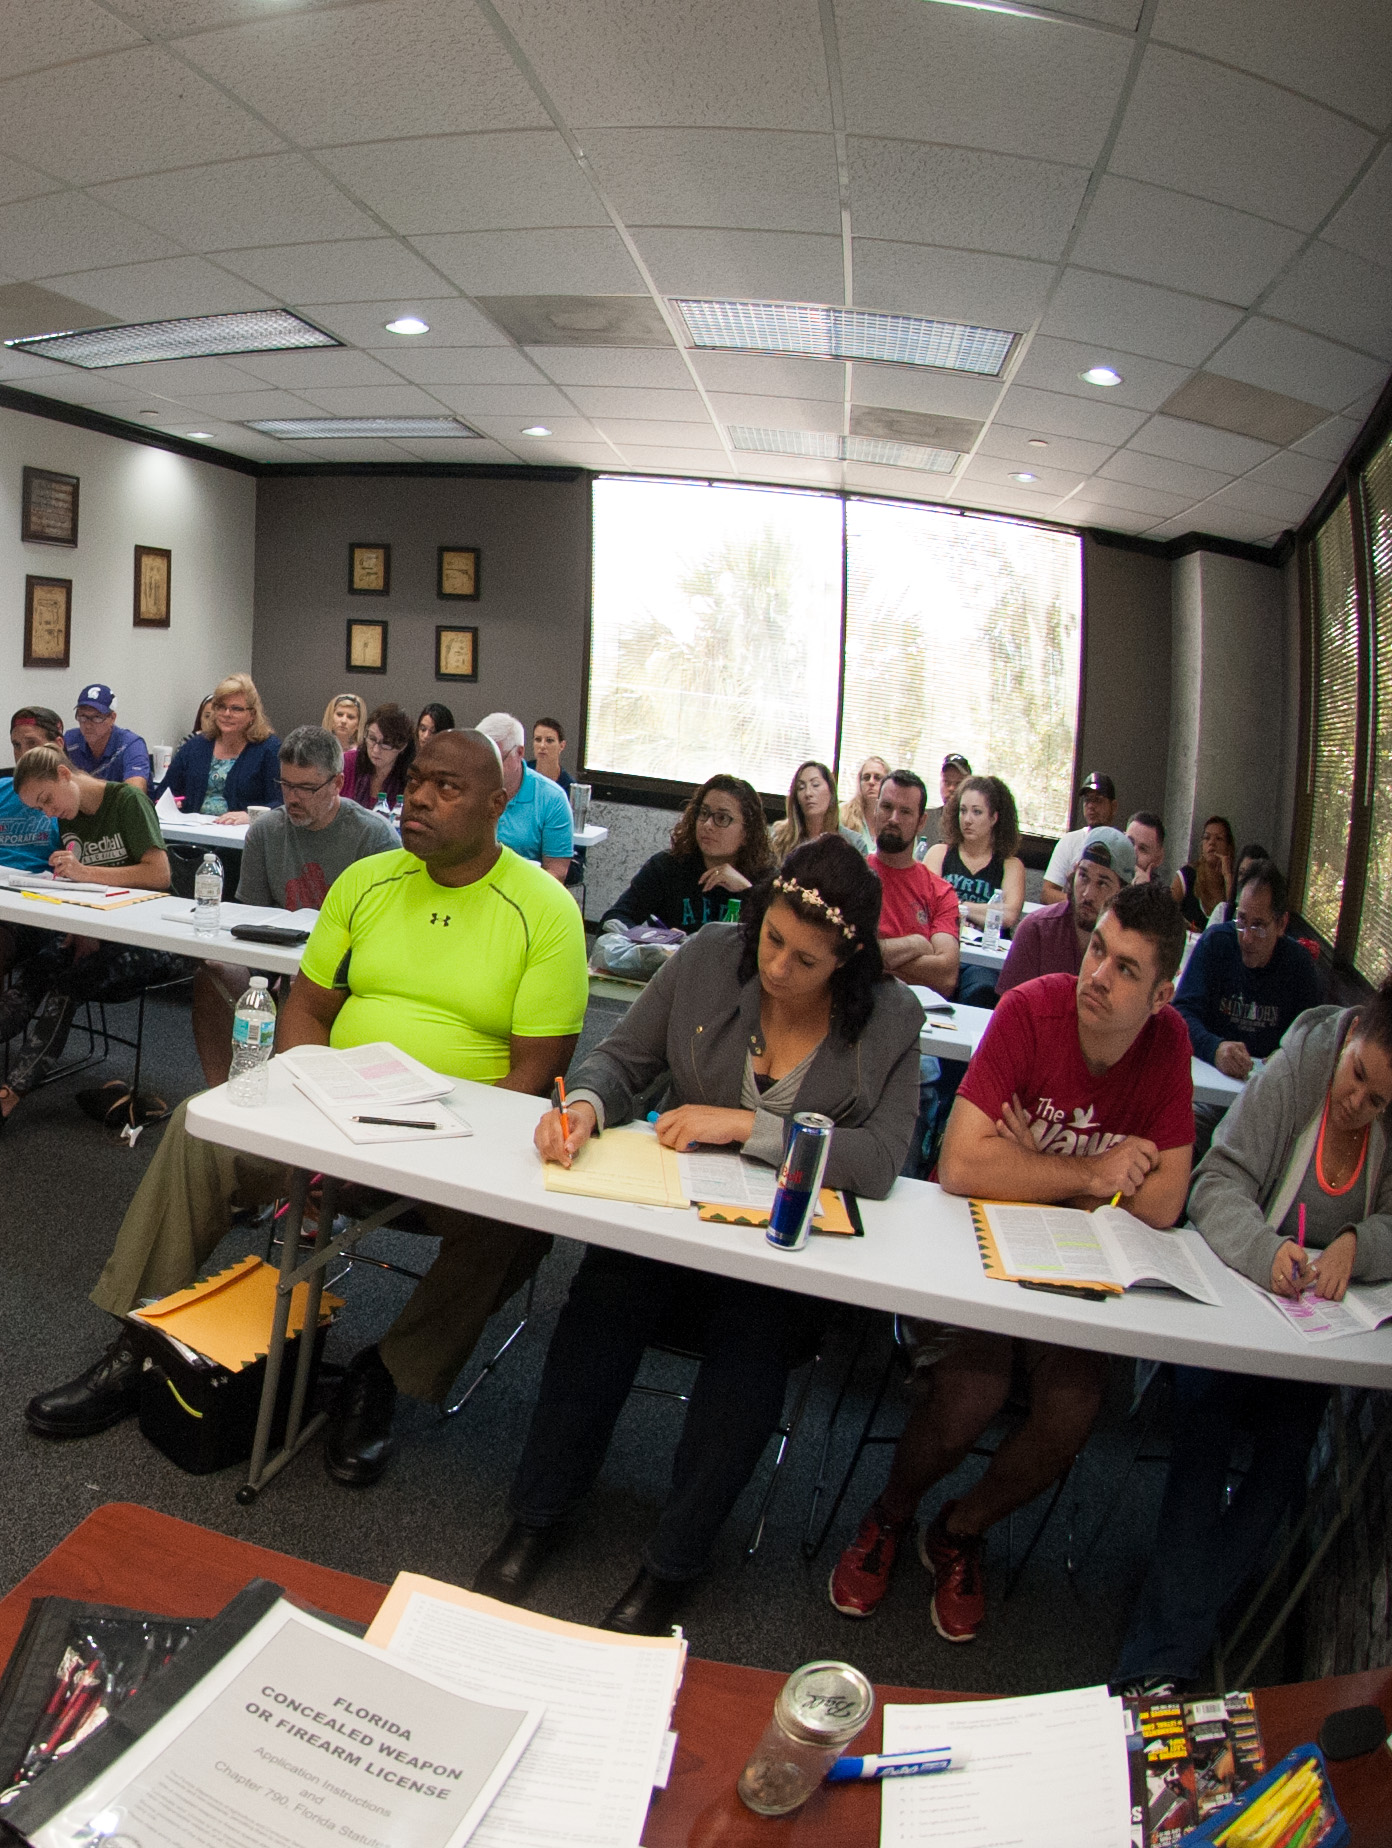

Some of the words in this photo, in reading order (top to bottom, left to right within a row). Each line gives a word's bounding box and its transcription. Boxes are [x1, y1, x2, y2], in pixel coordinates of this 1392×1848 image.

[1035, 1097, 1065, 1123] The
[245, 1702, 273, 1723] OR
[275, 1718, 361, 1767] FIREARM
[364, 1762, 452, 1800] LICENSE
[261, 1685, 374, 1746] CONCEALED
[378, 1742, 463, 1780] WEAPON
[333, 1696, 412, 1741] FLORIDA
[214, 1760, 262, 1793] Chapter
[293, 1803, 336, 1831] Florida
[255, 1746, 320, 1785] Application
[323, 1779, 392, 1818] Instructions
[299, 1788, 325, 1805] and
